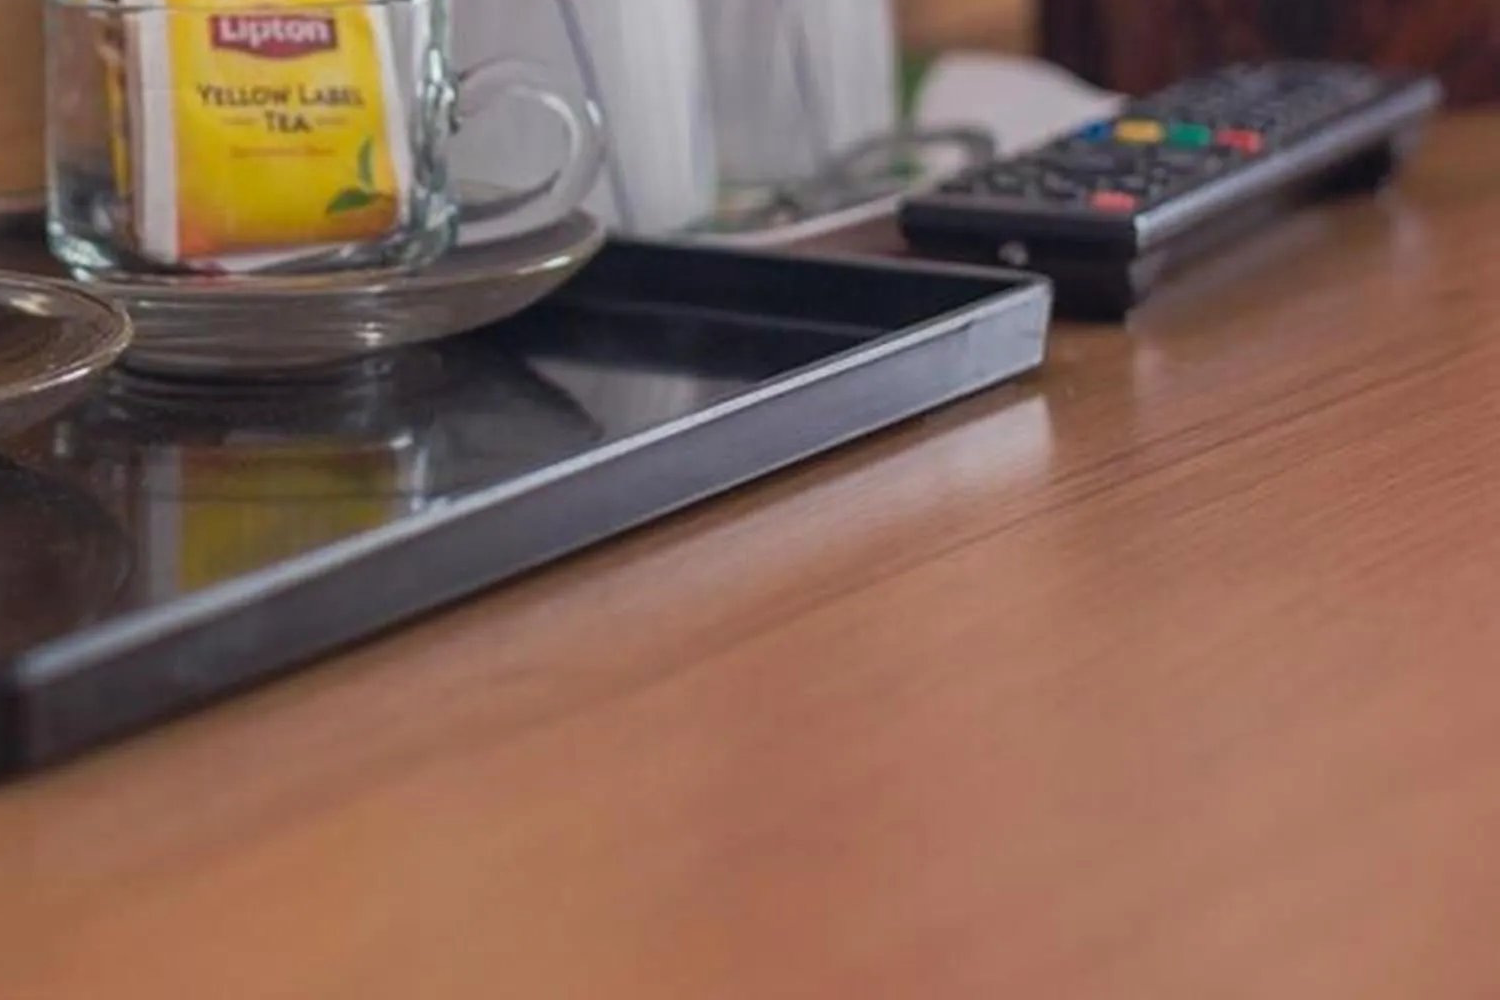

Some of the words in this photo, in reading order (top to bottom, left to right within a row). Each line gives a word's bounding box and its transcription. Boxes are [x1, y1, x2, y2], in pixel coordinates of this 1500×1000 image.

[218, 16, 329, 46] Lipton
[198, 83, 291, 108] YELLOW
[299, 83, 365, 106] LABEL
[262, 111, 313, 134] TEA
